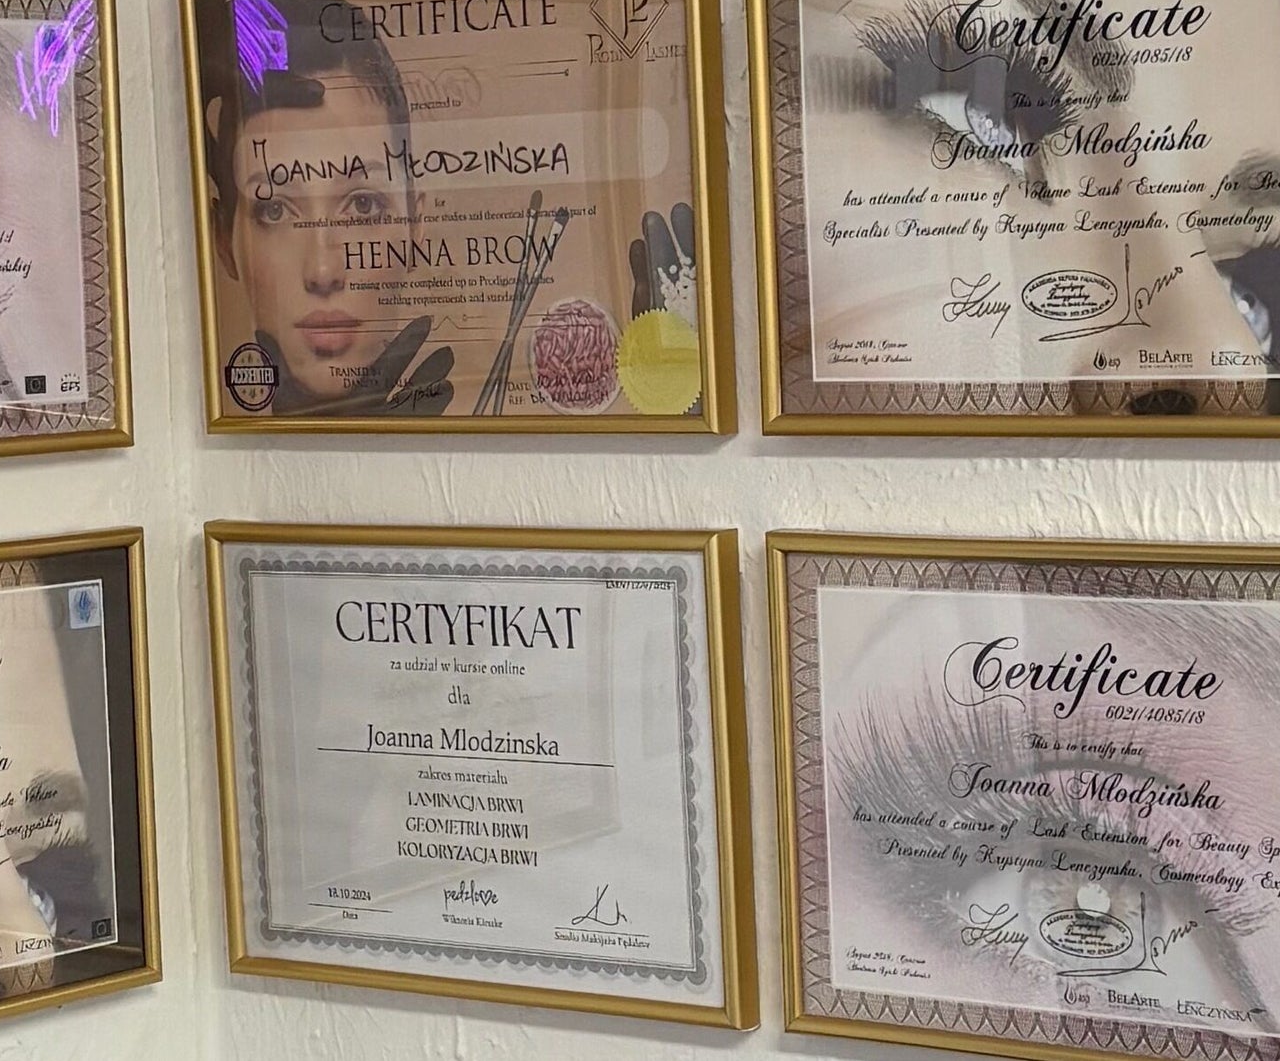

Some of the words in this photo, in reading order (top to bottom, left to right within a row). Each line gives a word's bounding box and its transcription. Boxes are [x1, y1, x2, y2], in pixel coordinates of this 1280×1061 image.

[253, 139, 368, 200] JOANNA
[931, 130, 1039, 170] Joanna
[1048, 120, 1213, 168] Młodzińska
[345, 238, 455, 270] HENNA
[467, 233, 561, 266] BROW
[336, 601, 580, 649] CERTYFIKAT
[944, 637, 1223, 720] Certificate
[367, 724, 433, 752] Joanna
[440, 728, 559, 757] Mlodzinska
[948, 763, 1055, 799] Joanna
[1066, 770, 1226, 818] Młodzińska
[397, 842, 497, 865] KOLORYZACJA
[501, 847, 538, 867] BRWI
